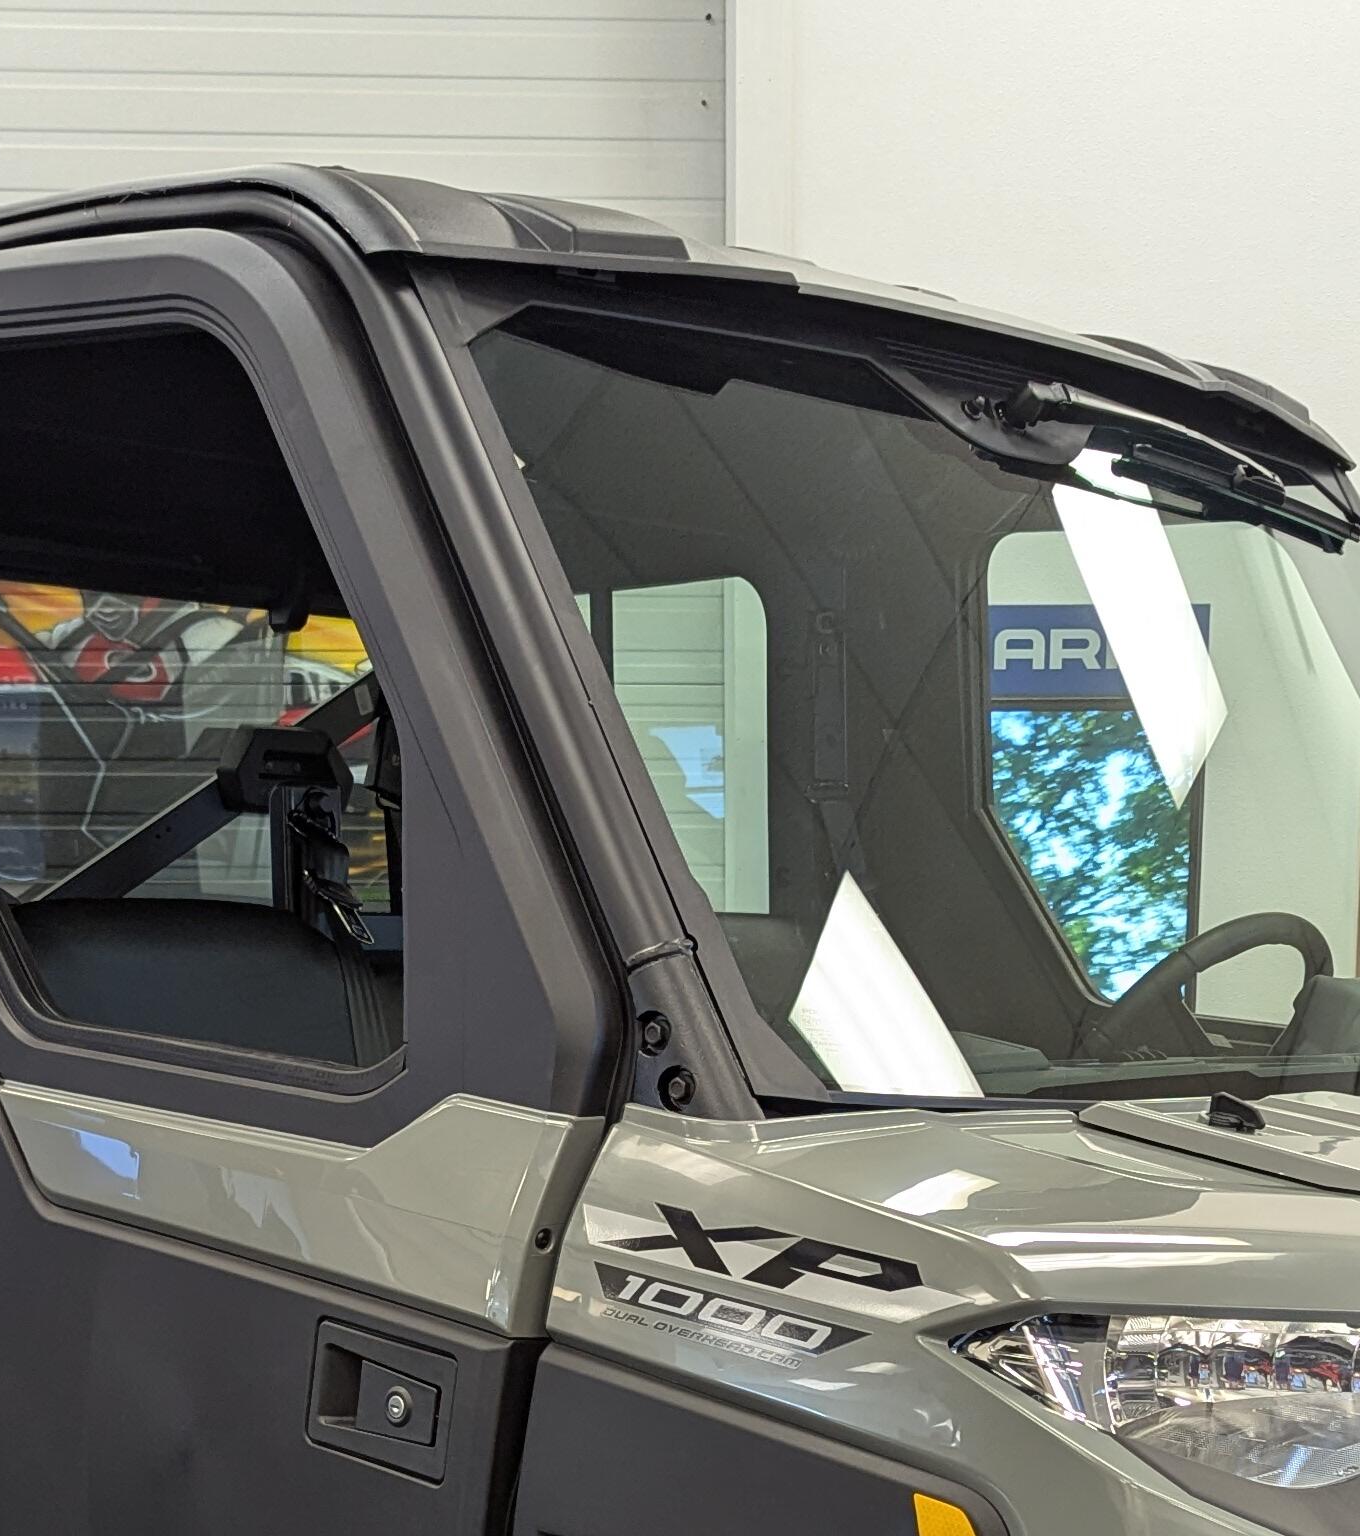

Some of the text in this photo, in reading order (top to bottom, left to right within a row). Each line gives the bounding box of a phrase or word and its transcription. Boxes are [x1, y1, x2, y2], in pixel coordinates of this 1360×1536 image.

[598, 1201, 925, 1292] XP
[601, 1307, 803, 1369] DUAL OVERHEAD CAM
[617, 1274, 833, 1351] 1000
